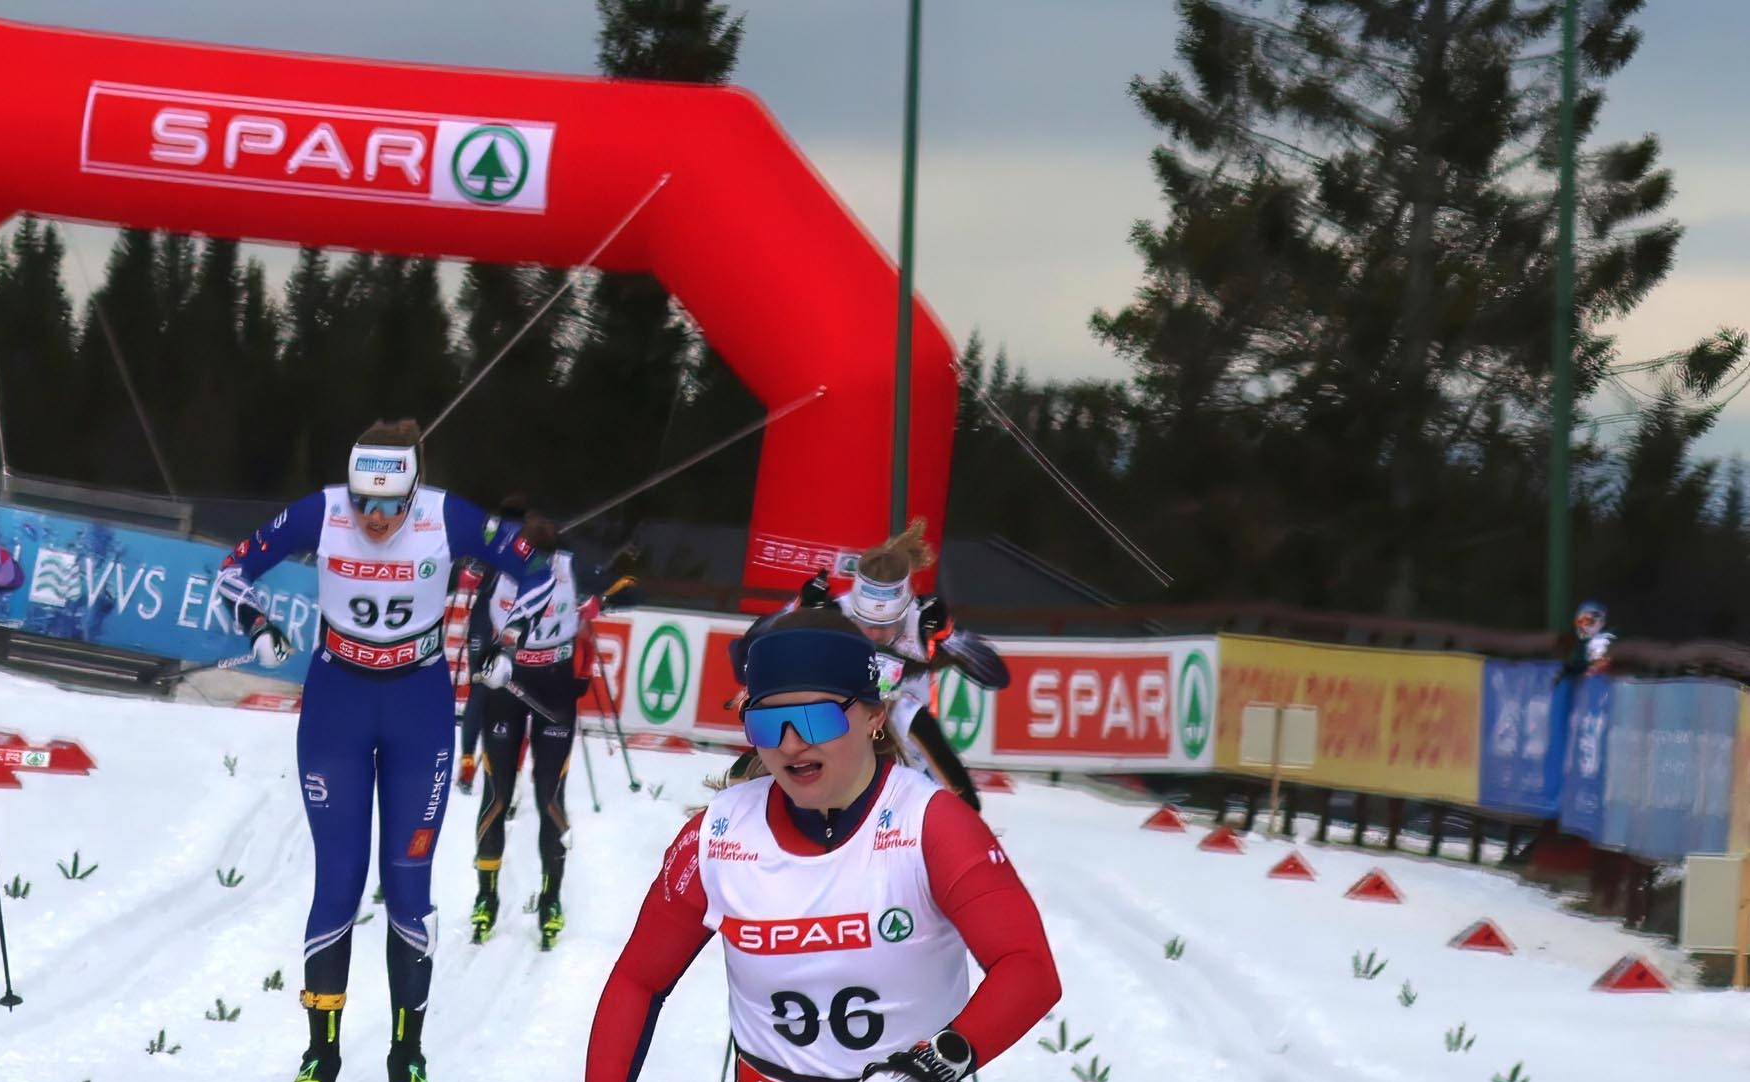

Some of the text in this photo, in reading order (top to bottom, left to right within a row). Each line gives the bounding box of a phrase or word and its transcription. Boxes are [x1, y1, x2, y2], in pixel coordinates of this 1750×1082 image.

[149, 106, 428, 185] SPAR
[84, 556, 166, 620] VVS
[340, 562, 412, 579] SPAR
[349, 596, 414, 630] 95
[339, 640, 414, 665] SPAR
[1027, 668, 1169, 740] SPAR
[738, 918, 866, 950] SPAR
[771, 986, 884, 1050] 96
